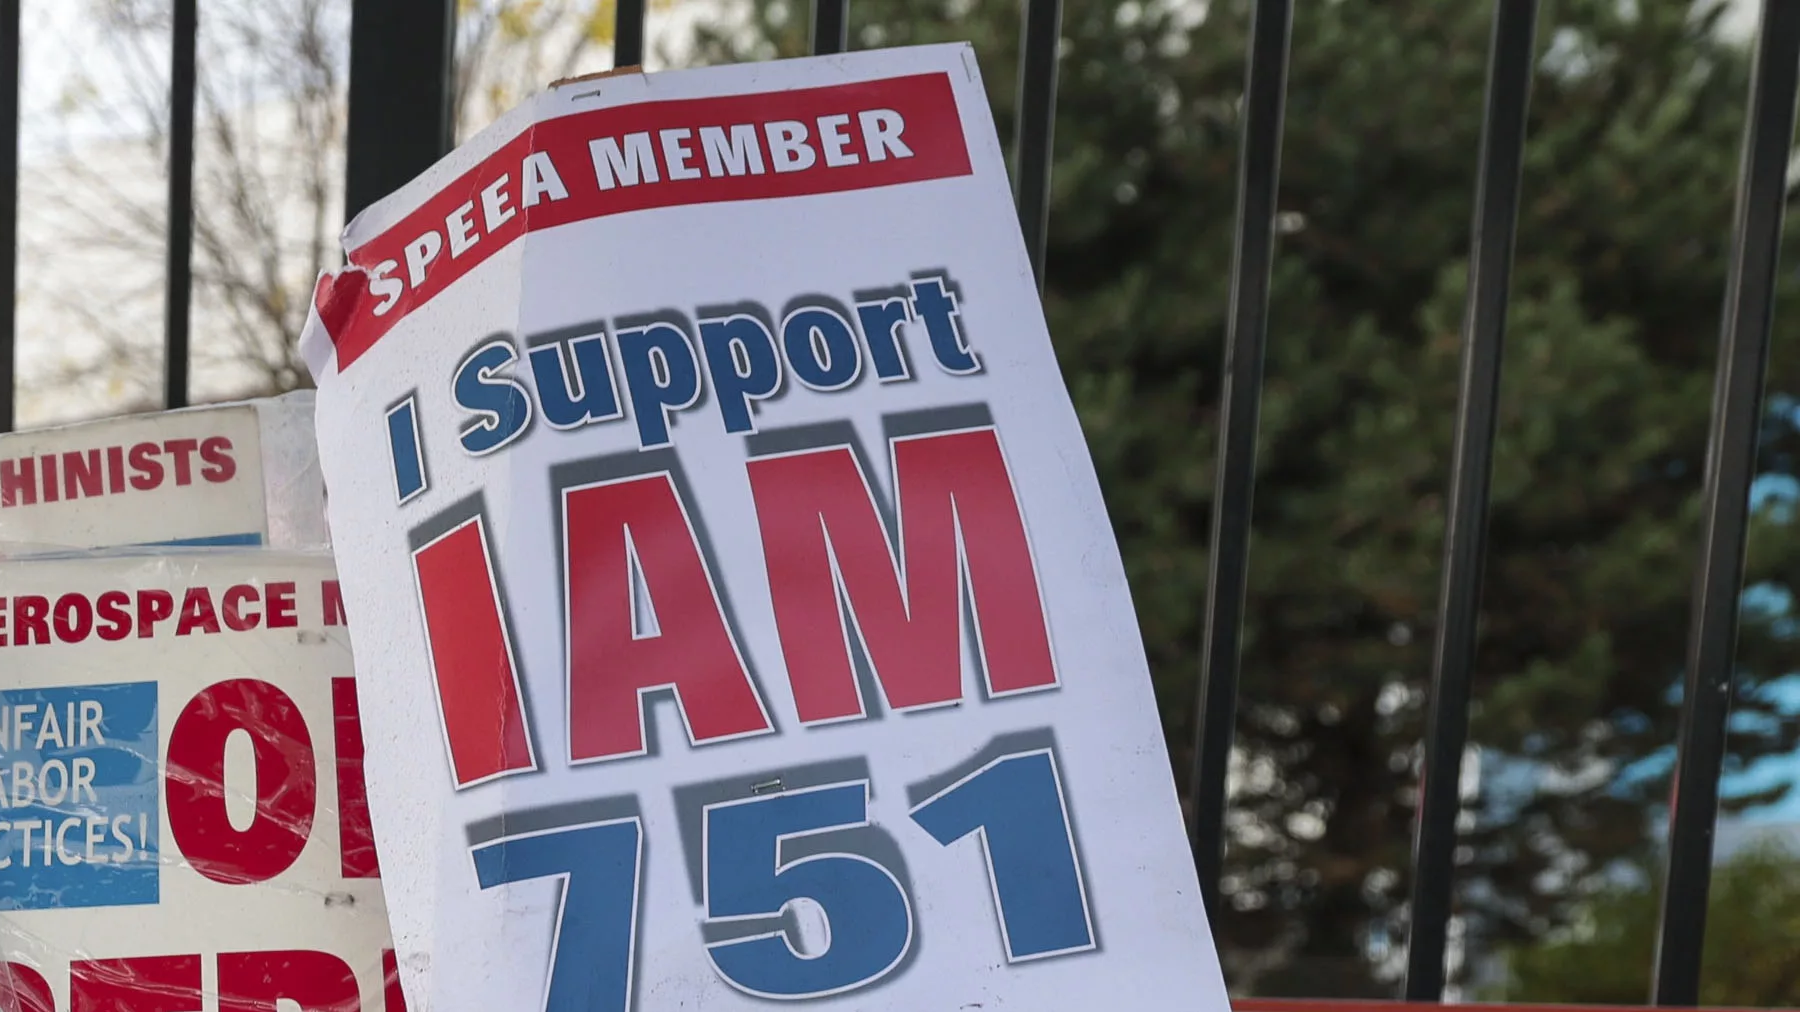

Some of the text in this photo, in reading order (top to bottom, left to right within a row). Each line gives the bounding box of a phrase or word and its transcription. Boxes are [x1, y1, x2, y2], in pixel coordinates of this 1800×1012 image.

[369, 107, 914, 317] SPEEA MEMBER
[385, 275, 982, 505] I Support
[411, 424, 1060, 792] IAM
